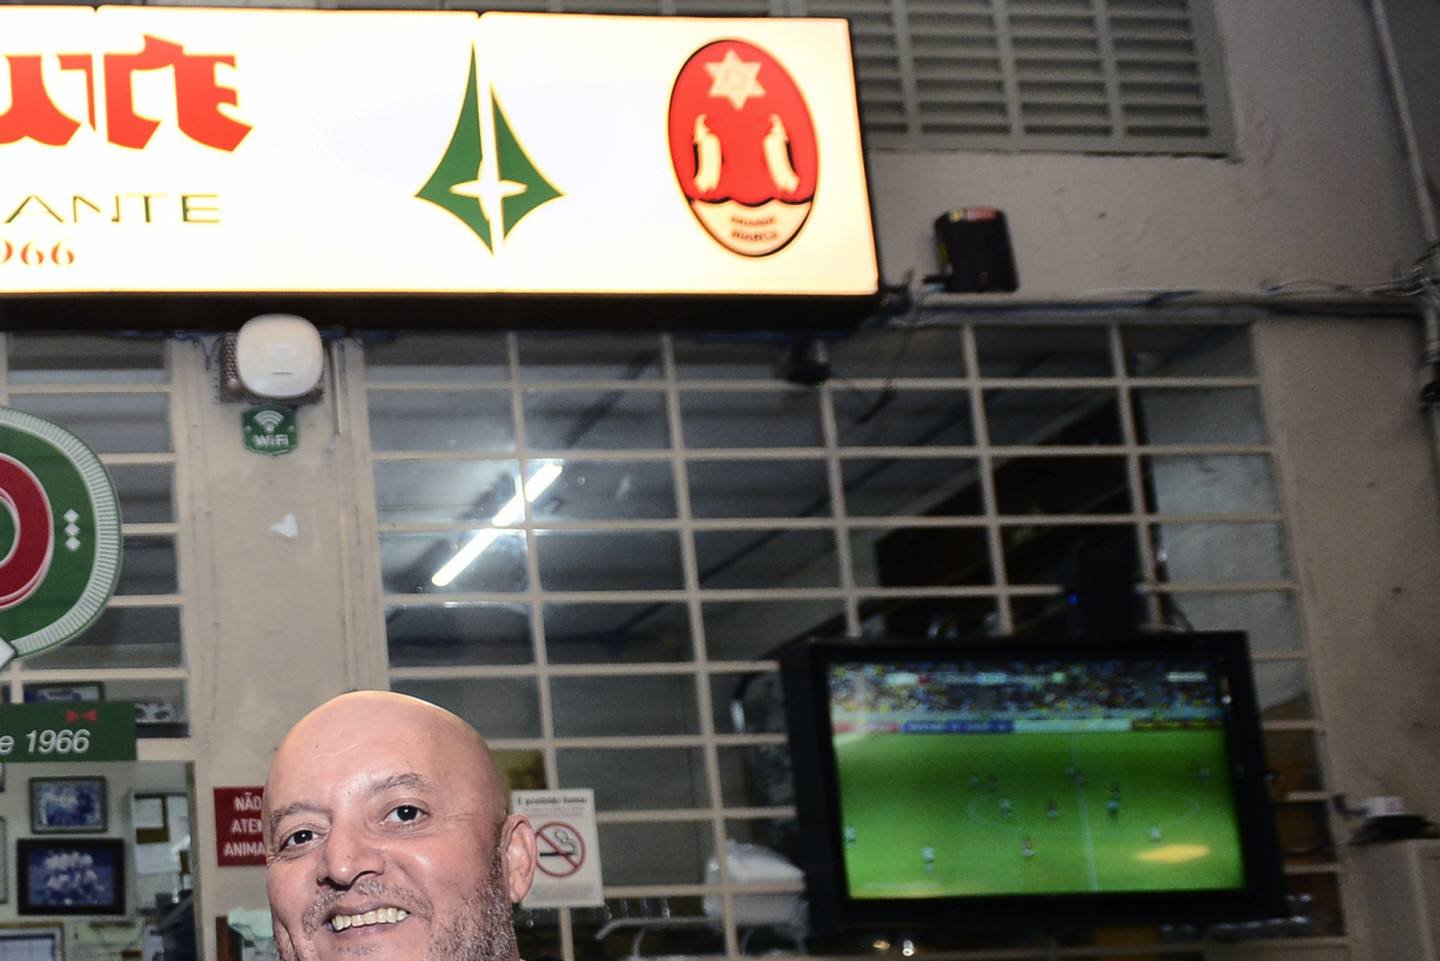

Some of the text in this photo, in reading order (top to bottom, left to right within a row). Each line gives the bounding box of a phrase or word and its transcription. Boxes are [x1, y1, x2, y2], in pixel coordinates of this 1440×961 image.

[26, 729, 91, 754] 1966
[234, 792, 262, 811] NÃO
[231, 818, 262, 833] ATE
[224, 841, 266, 856] ANIMA
